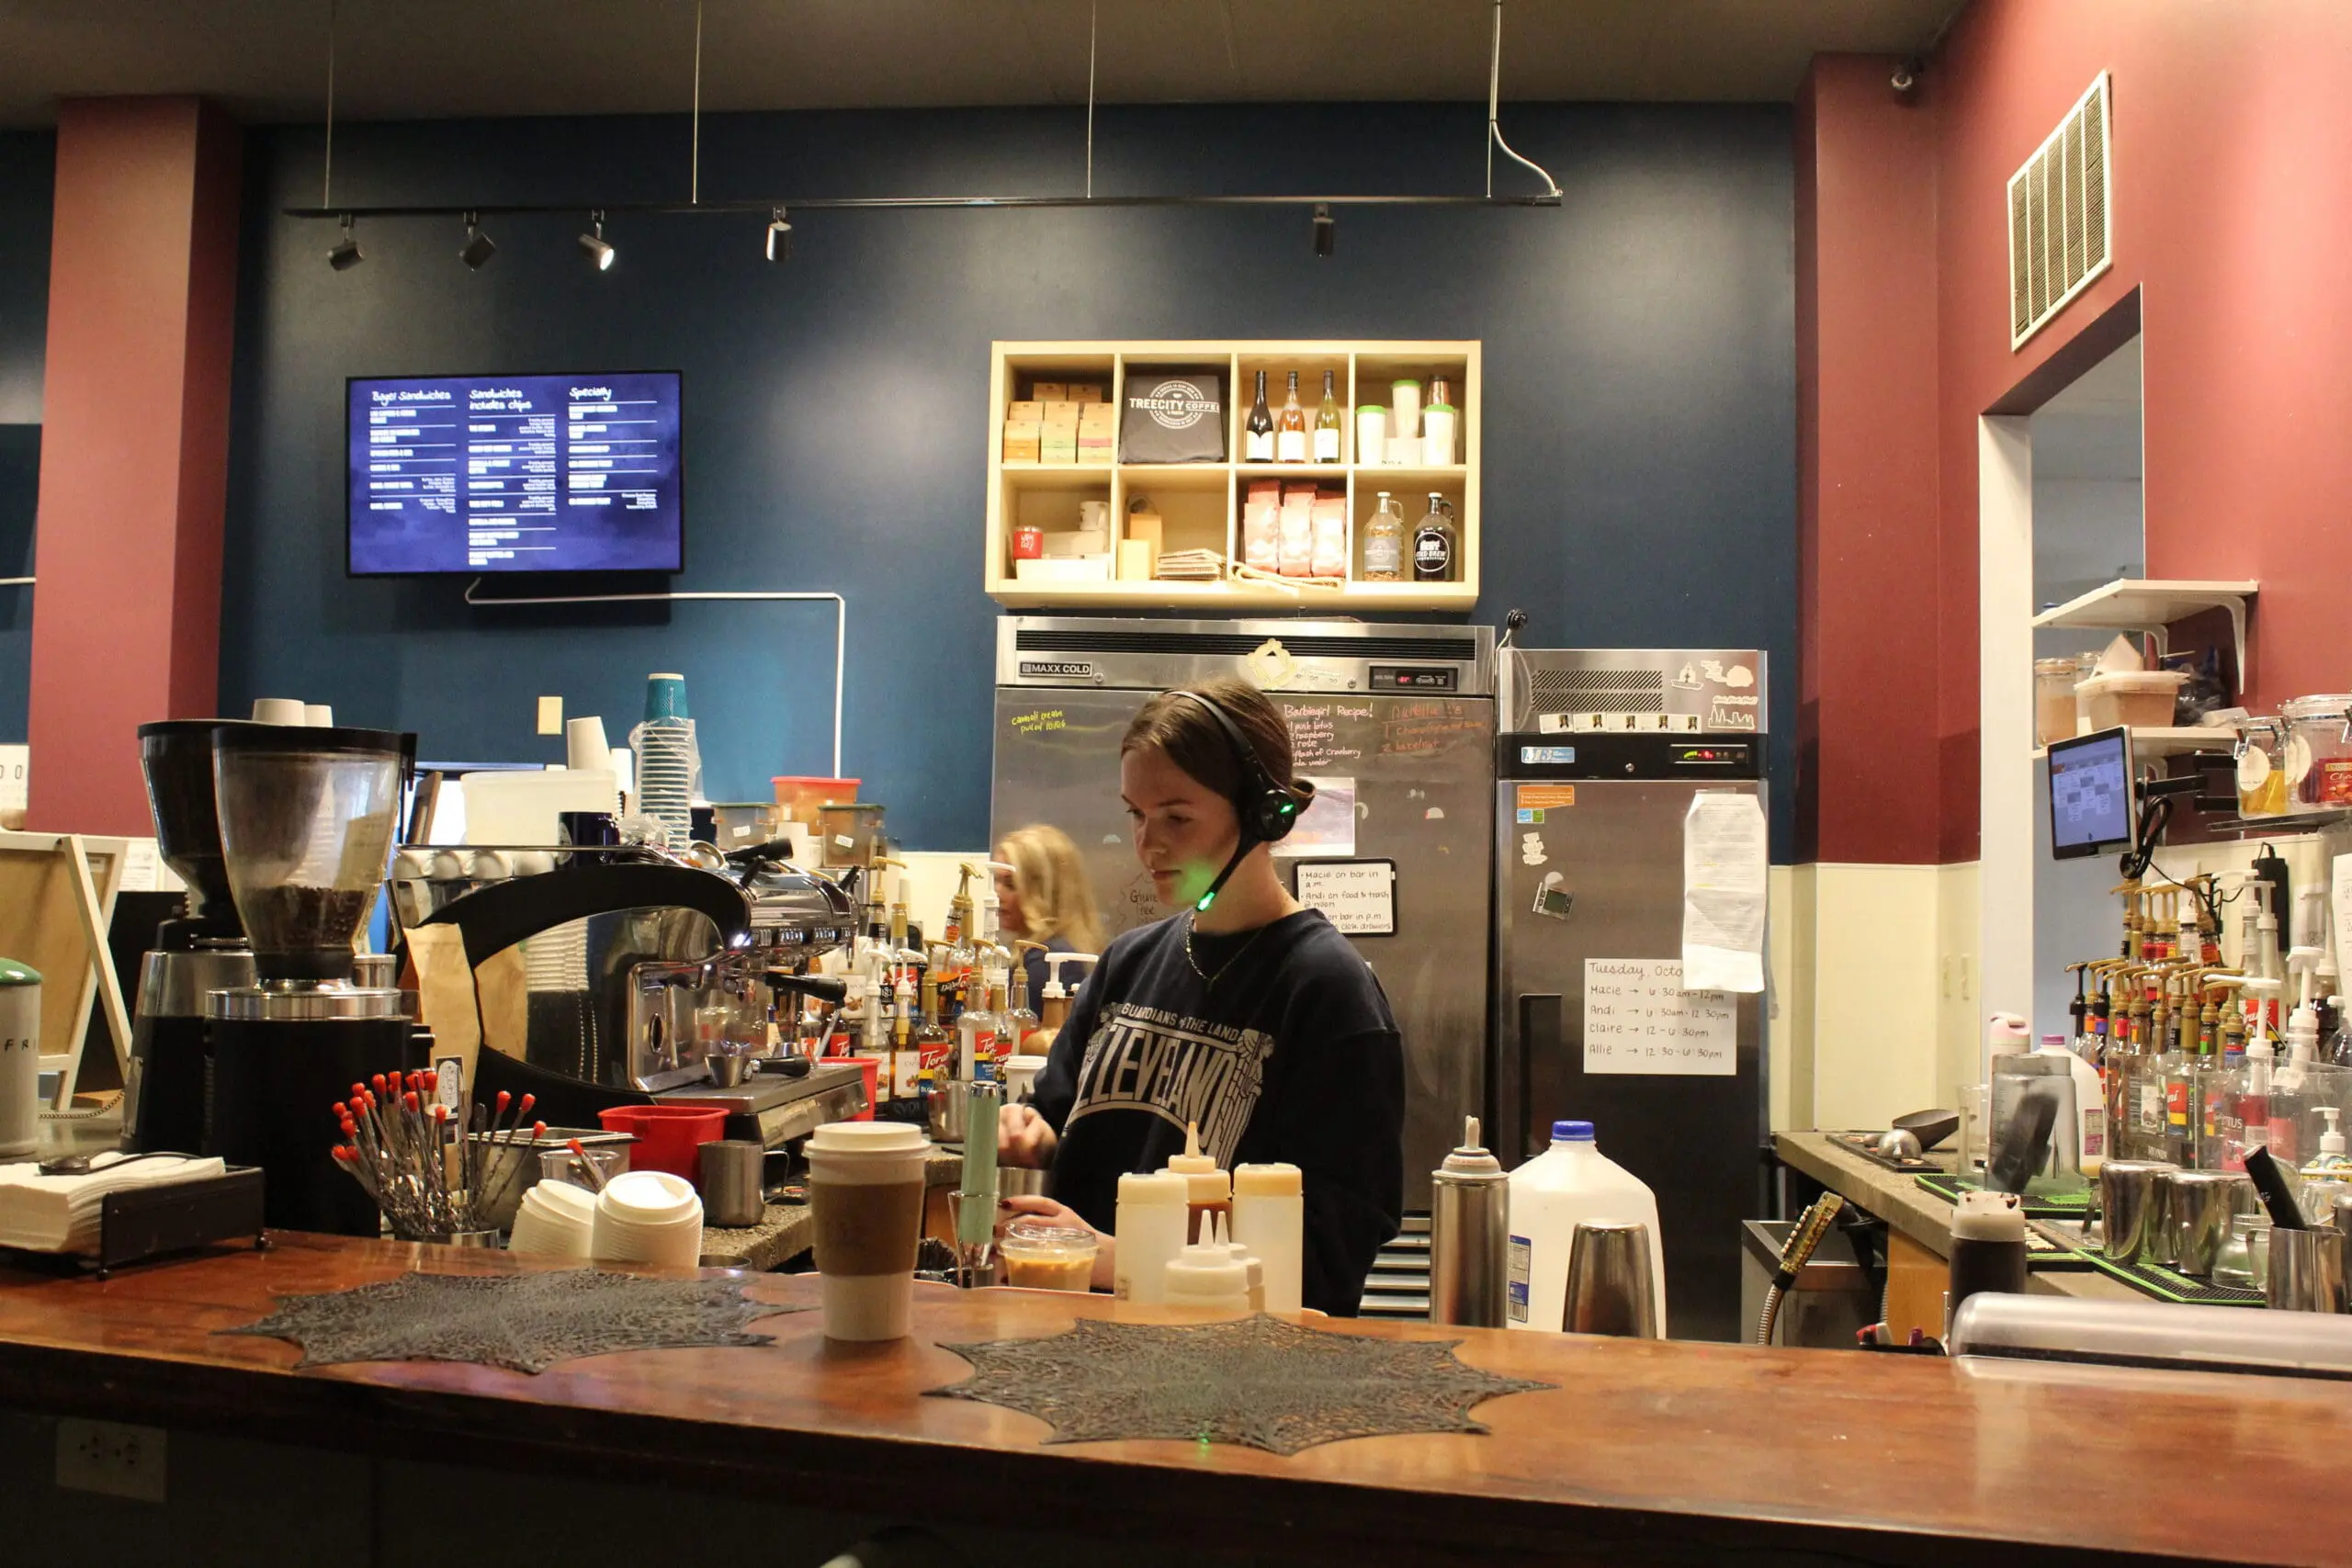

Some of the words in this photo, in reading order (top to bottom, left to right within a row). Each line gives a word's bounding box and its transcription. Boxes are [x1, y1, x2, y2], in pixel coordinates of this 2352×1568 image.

[398, 389, 451, 401] Sandwiches
[469, 388, 523, 399] Sandwiches
[569, 387, 612, 401] Specialty
[469, 400, 505, 410] includes
[508, 399, 532, 412] chips
[1129, 398, 1184, 410] TREECITY
[1031, 663, 1061, 674] MAXX
[1062, 663, 1091, 674] COLD
[1306, 872, 1331, 880] Macie
[1350, 871, 1366, 879] bar
[1655, 965, 1683, 977] Octo
[1590, 985, 1623, 996] Macie
[1589, 1005, 1616, 1016] Andi
[1121, 1002, 1178, 1027] GUARDIANS
[1185, 1016, 1206, 1034] THE
[1207, 1020, 1240, 1042] LAND
[1589, 1043, 1612, 1055] Allie
[1079, 1024, 1239, 1152] LEVELAND
[893, 1100, 929, 1118] SYRU
